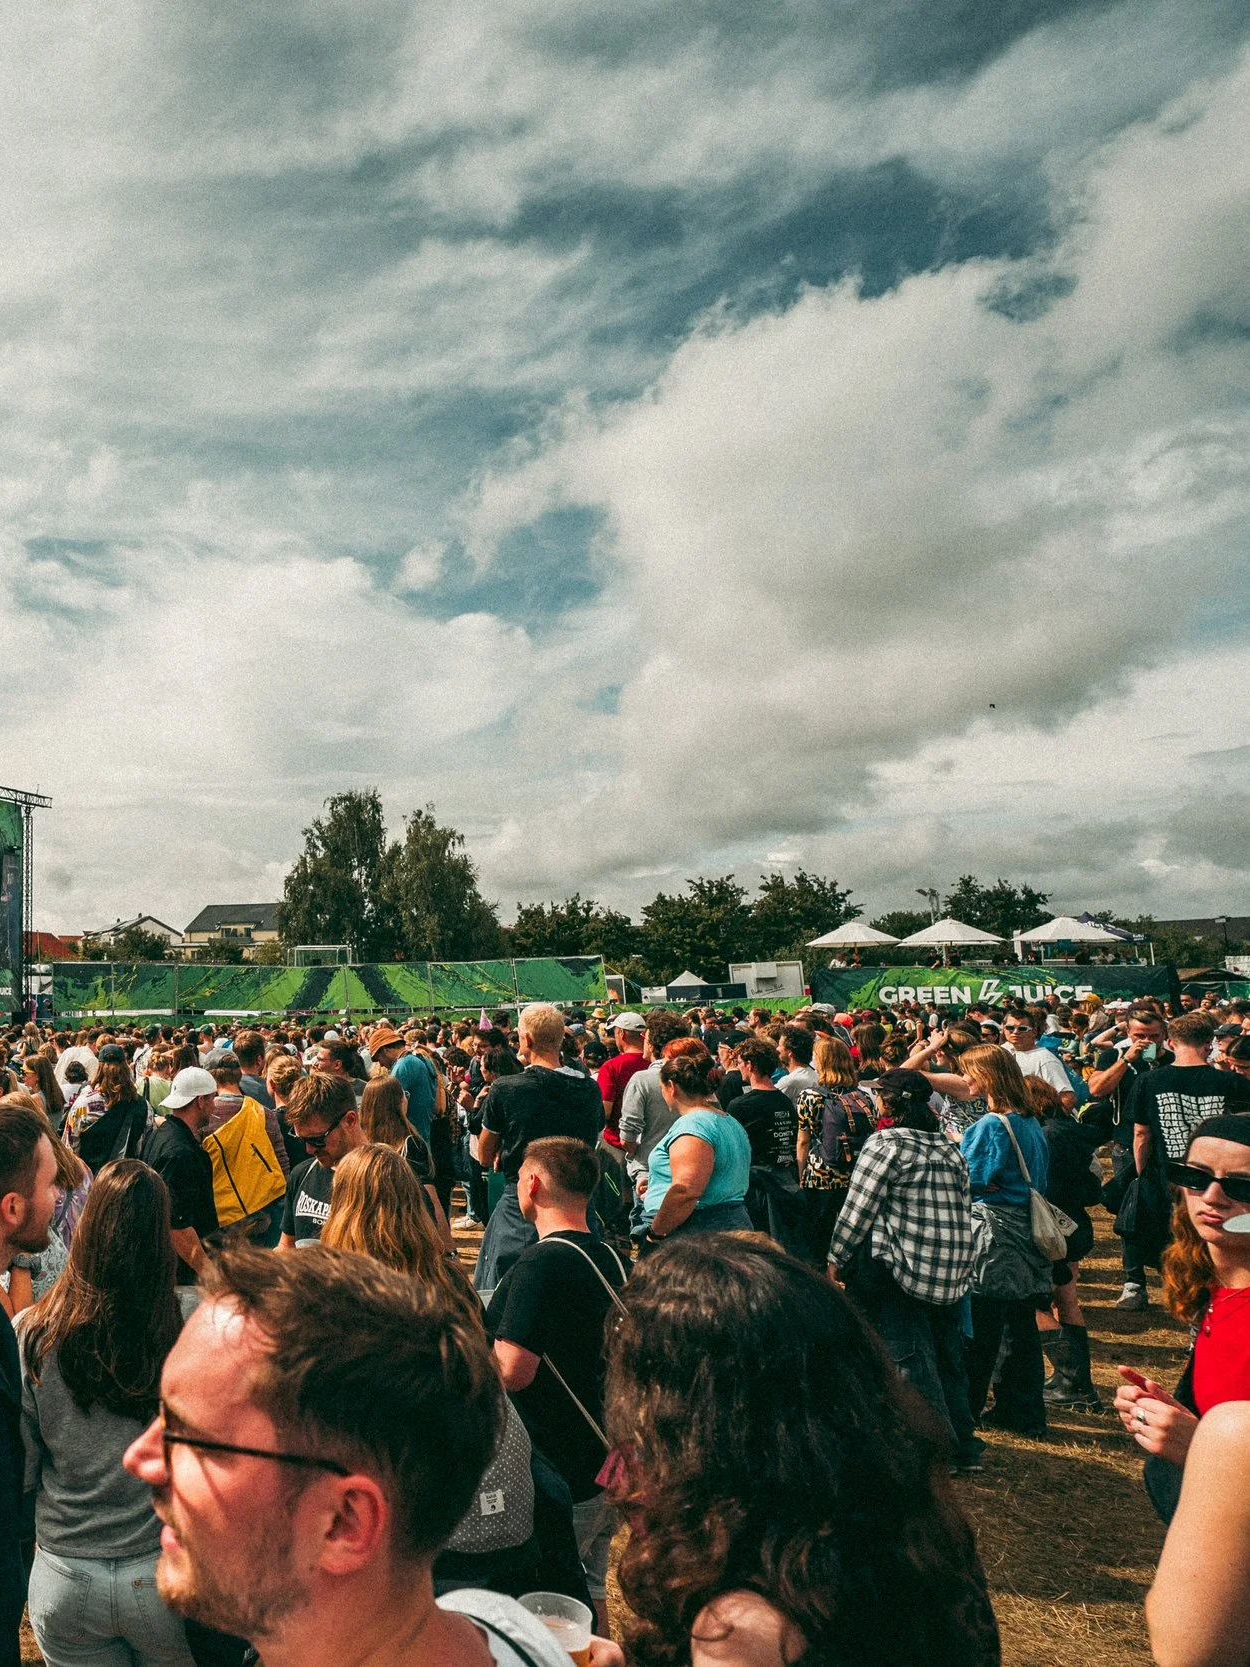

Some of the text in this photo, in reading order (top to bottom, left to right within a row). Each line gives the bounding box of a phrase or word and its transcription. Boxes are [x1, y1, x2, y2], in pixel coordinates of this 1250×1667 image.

[878, 985, 1093, 1005] GREEN JUICE
[1155, 1092, 1225, 1104] TAKE ME AWAY
[1157, 1098, 1225, 1111] TAKE ME AWAY
[1158, 1104, 1182, 1113] TAKE
[1183, 1107, 1199, 1116] ME
[1162, 1131, 1189, 1139] TAKE
